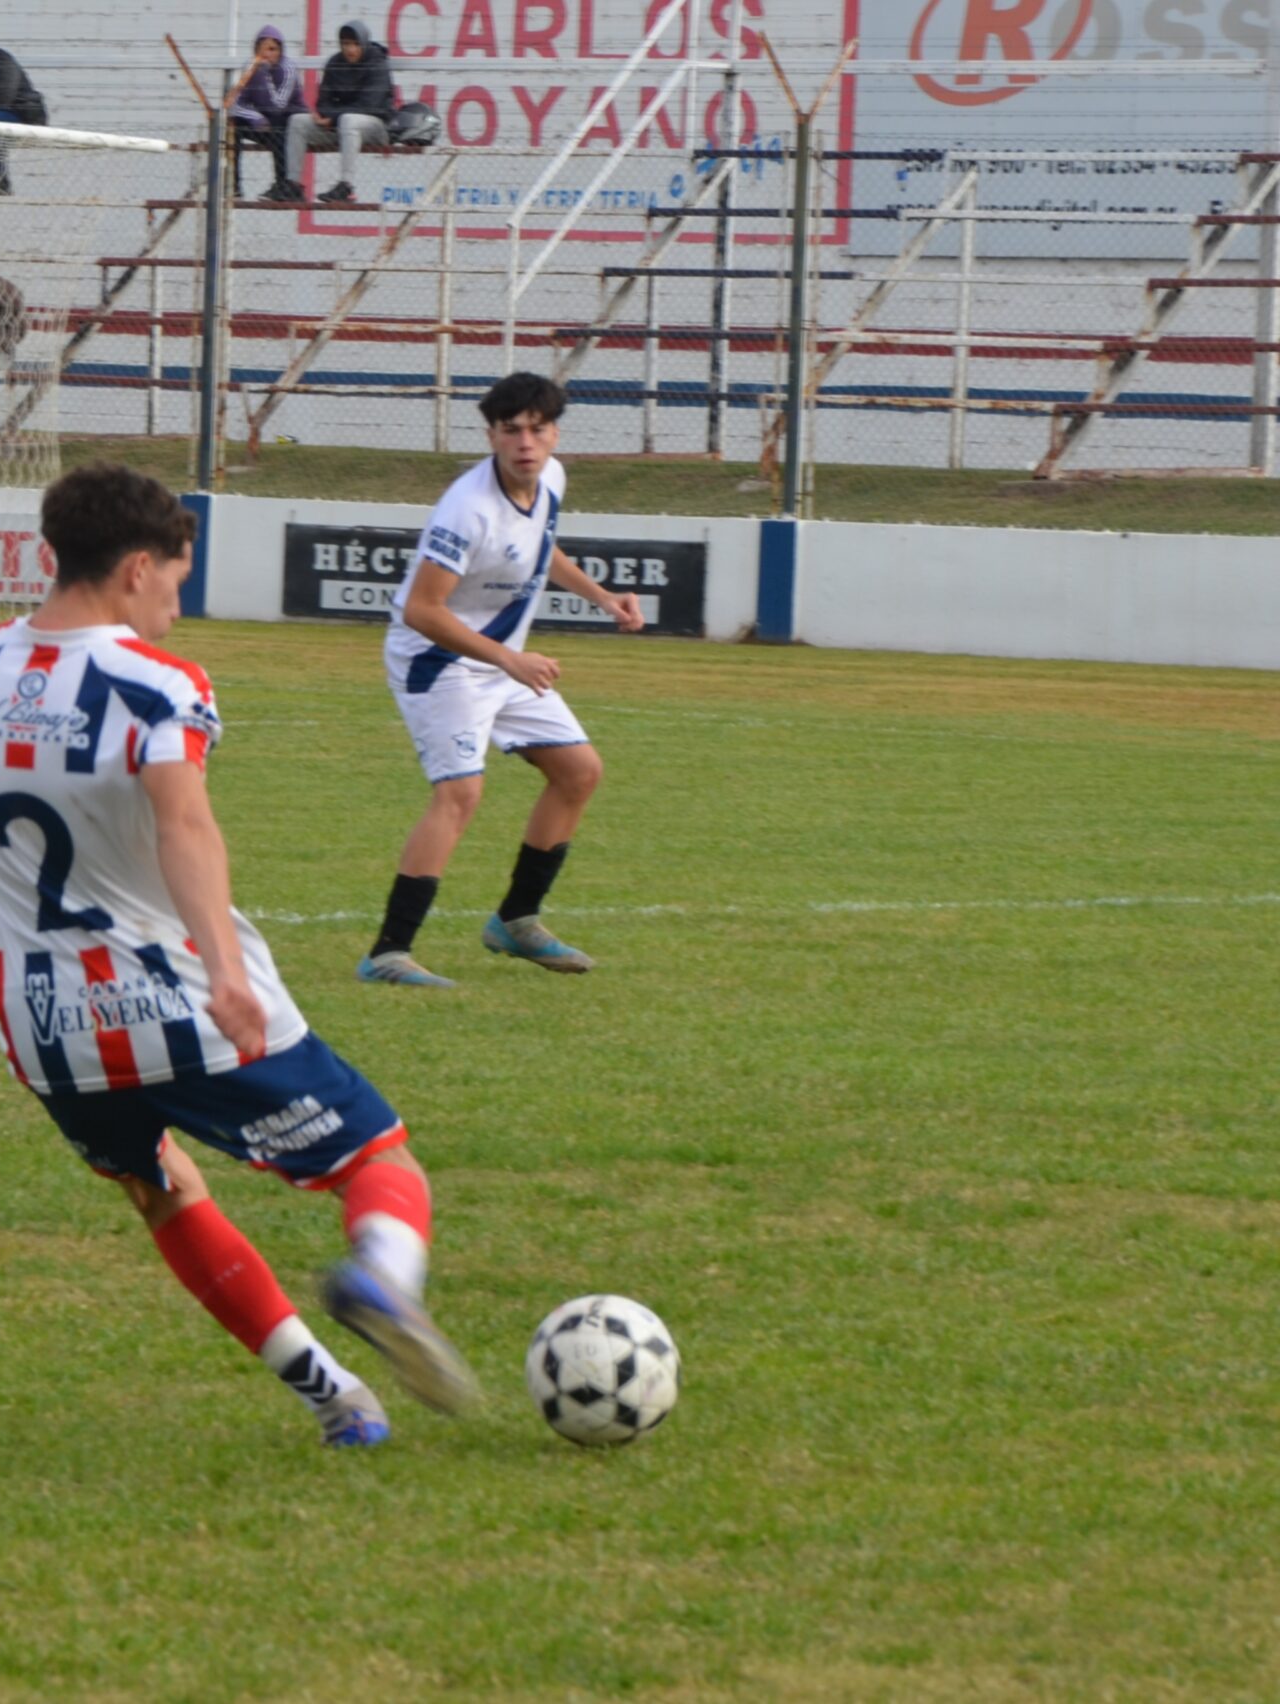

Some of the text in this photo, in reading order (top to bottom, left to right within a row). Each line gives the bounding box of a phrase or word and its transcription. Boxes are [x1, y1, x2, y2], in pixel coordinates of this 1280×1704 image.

[386, 0, 766, 60] CARLOS
[383, 186, 501, 205] PINTERIA
[532, 189, 657, 208] ERRTERIA
[313, 539, 420, 575] HÉCT
[566, 556, 669, 587] DER
[550, 597, 601, 616] RUR
